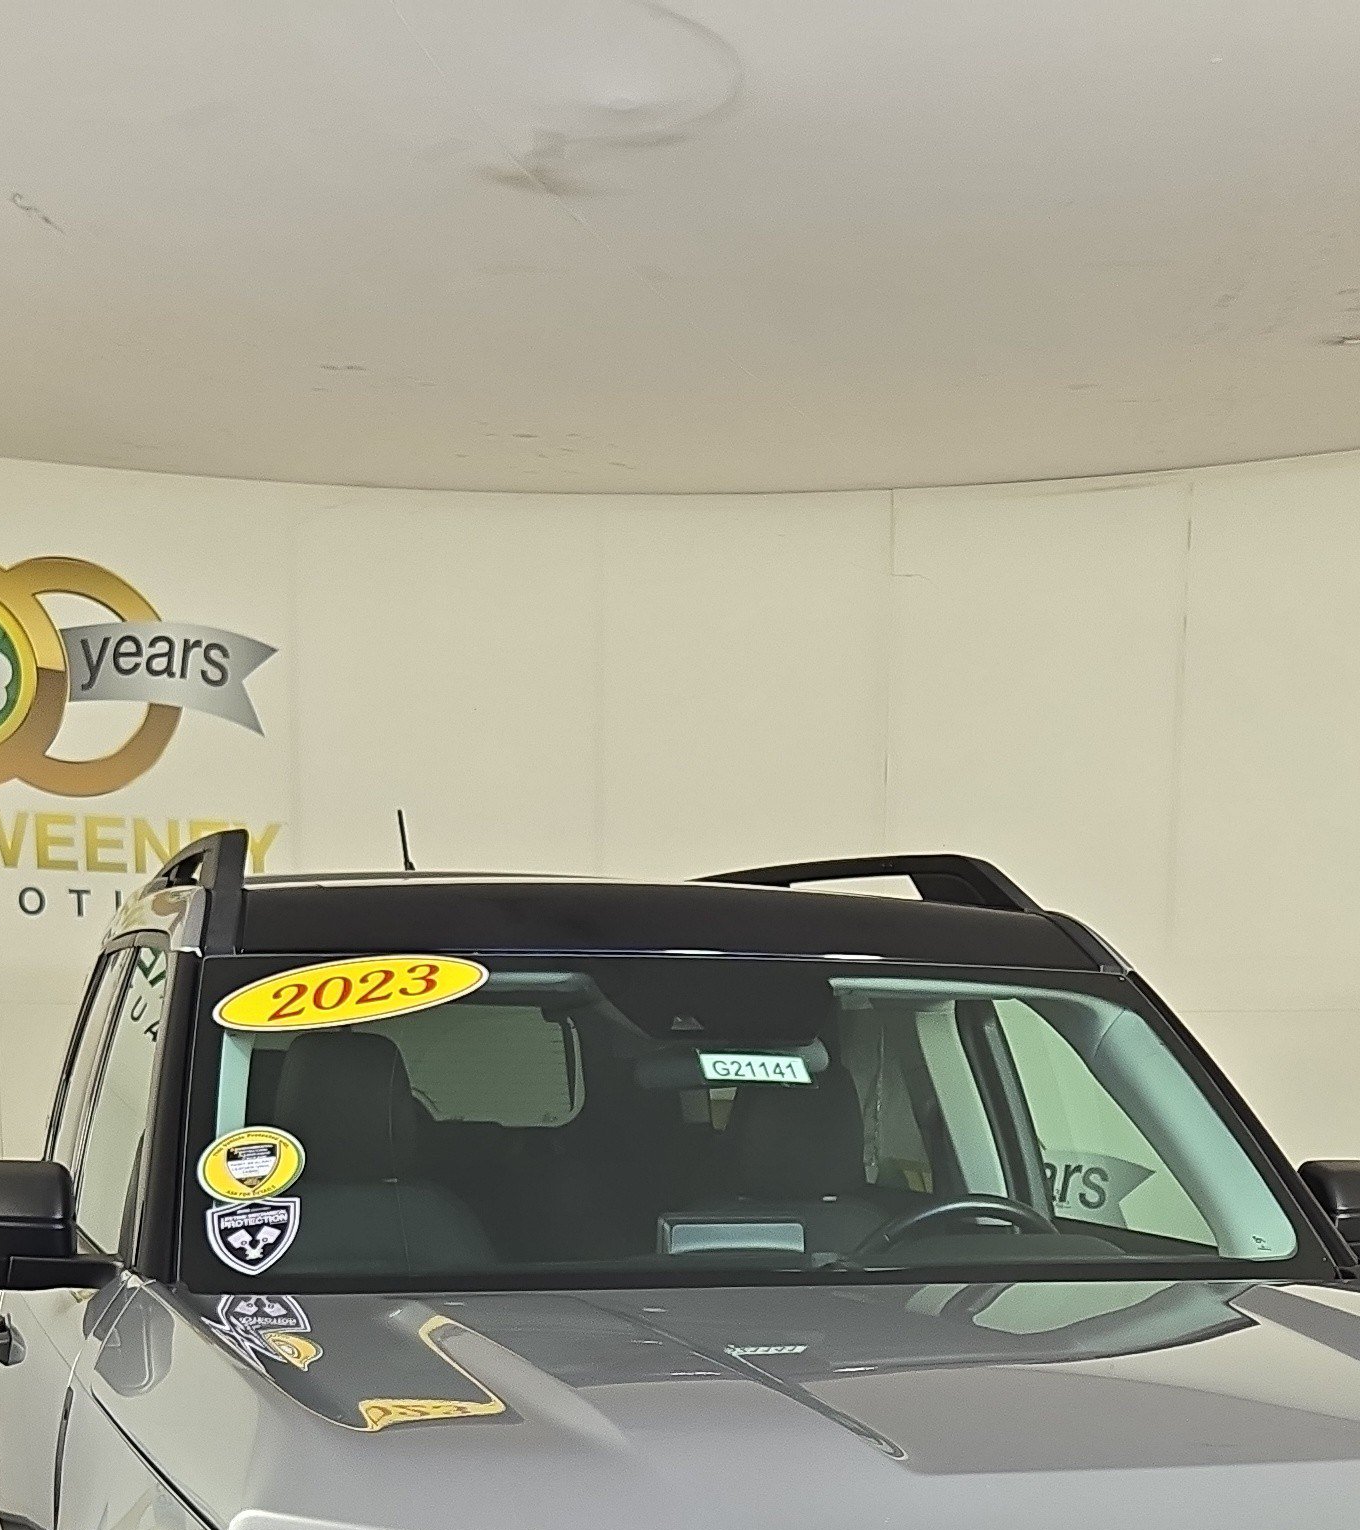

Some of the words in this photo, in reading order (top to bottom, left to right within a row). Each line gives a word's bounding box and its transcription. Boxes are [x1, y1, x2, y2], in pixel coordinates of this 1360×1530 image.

[79, 633, 231, 692] years
[267, 963, 441, 1022] 2023
[712, 1060, 798, 1079] G21141
